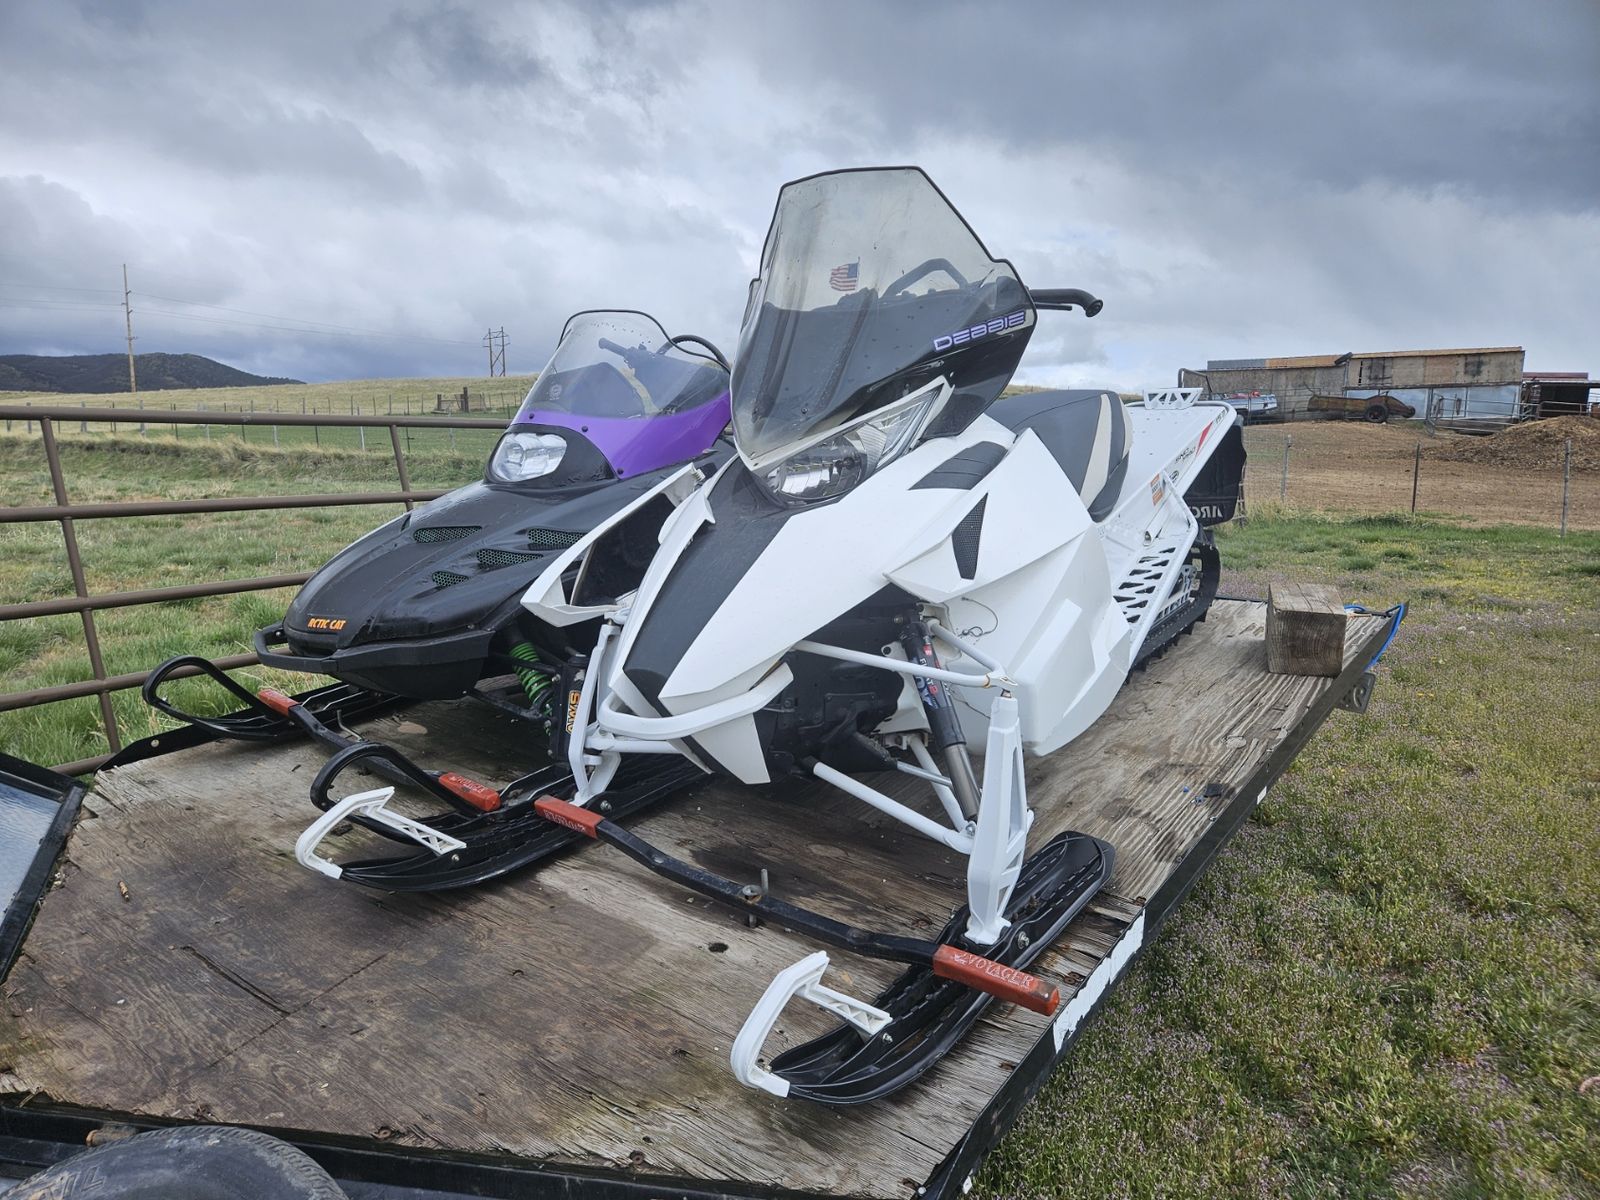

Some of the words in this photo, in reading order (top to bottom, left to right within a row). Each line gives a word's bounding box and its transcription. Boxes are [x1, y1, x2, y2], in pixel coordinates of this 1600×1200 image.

[933, 310, 1025, 351] DEBBIE
[329, 619, 347, 630] CAT
[965, 953, 1035, 989] VOYAGER
